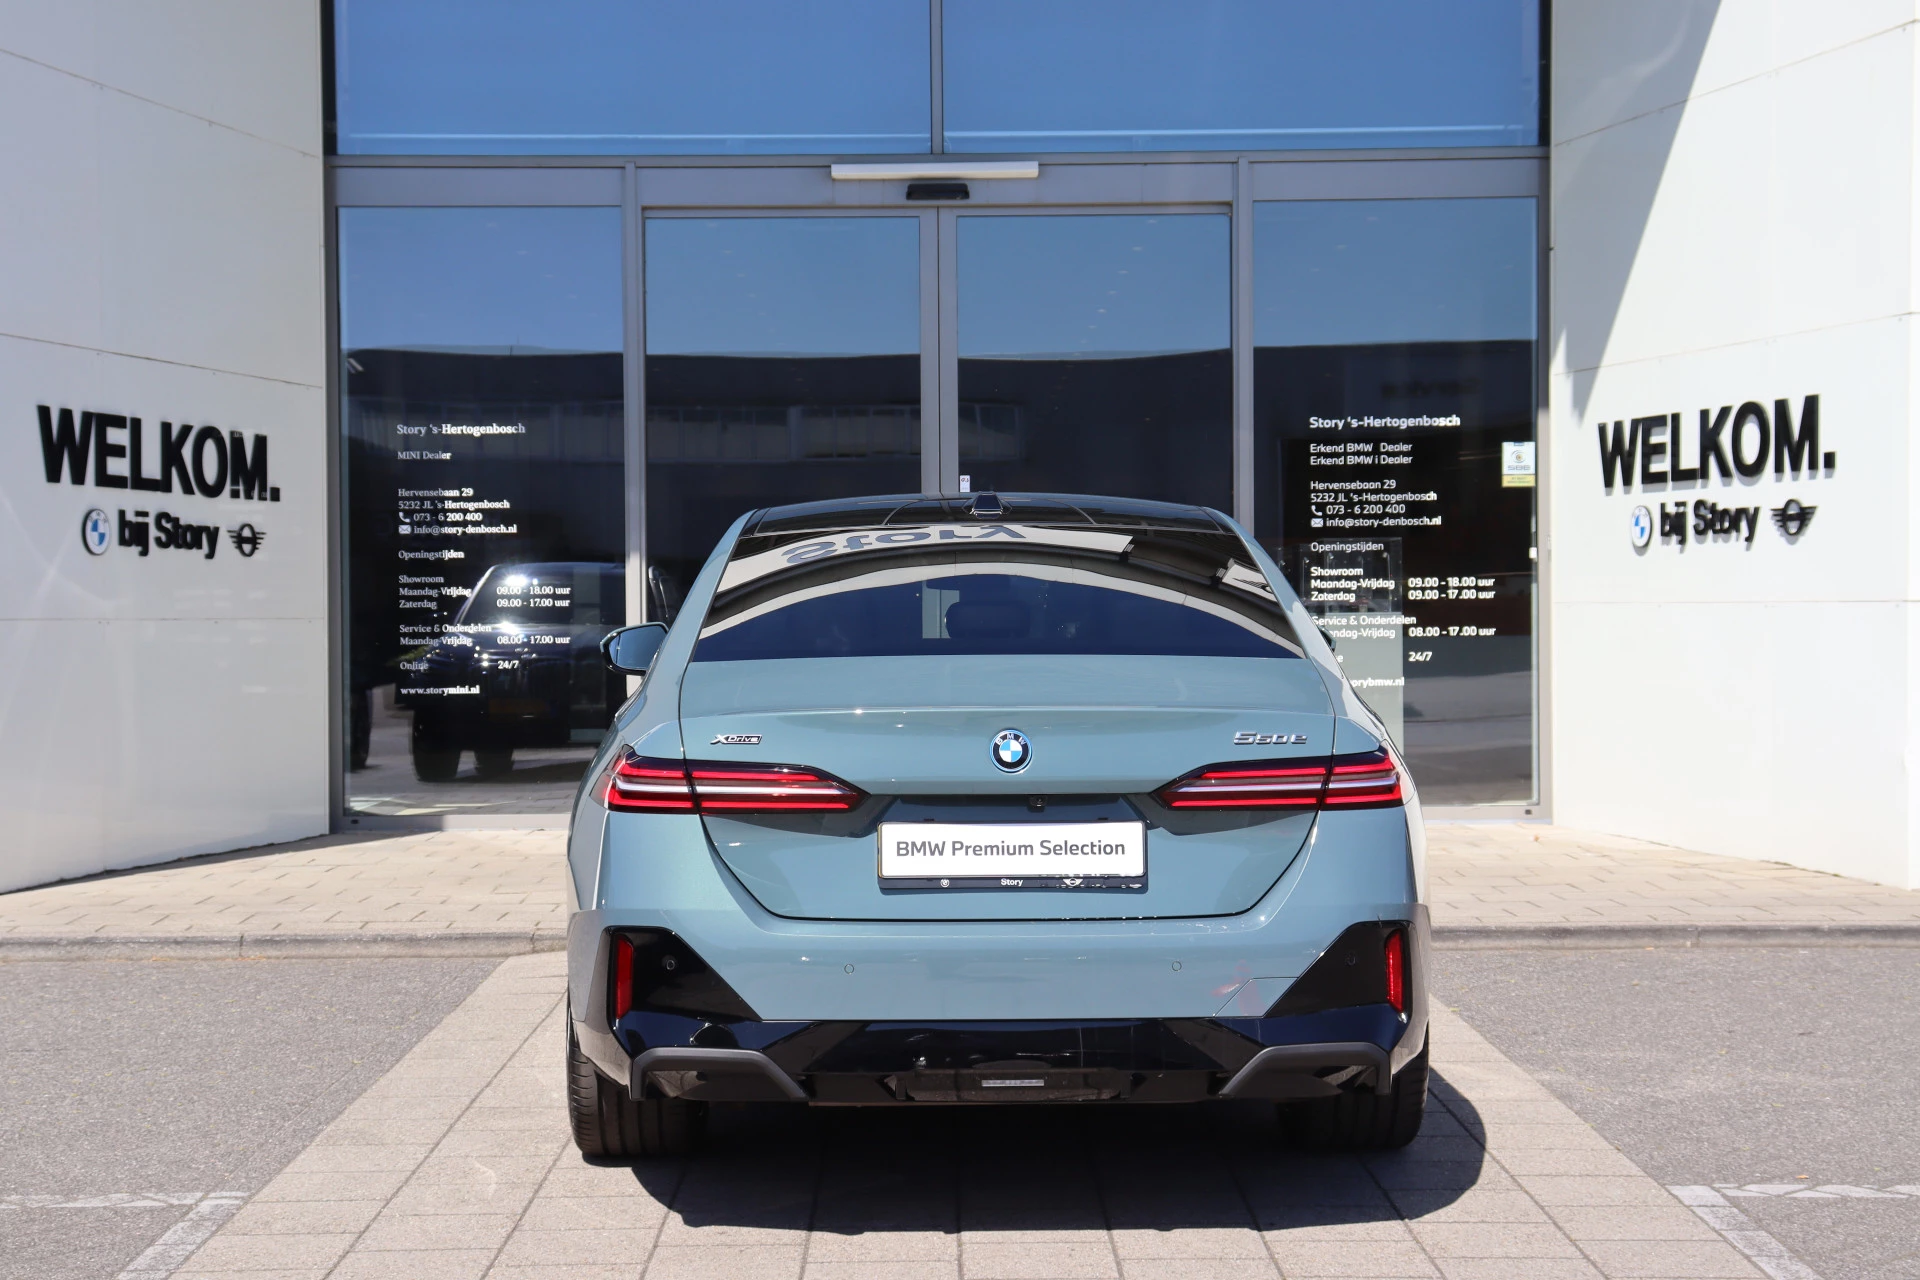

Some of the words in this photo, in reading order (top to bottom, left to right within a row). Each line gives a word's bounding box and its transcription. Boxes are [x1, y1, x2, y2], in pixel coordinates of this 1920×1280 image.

[1309, 417, 1344, 430] Story
[397, 424, 426, 436] Story
[1598, 394, 1836, 488] WELKOM.
[1310, 443, 1344, 452] Erkend
[1347, 443, 1373, 452] BMW
[1380, 443, 1412, 452] Dealer
[37, 405, 280, 502] WELKOM.
[423, 451, 451, 459] Dealer
[1310, 456, 1344, 465] Erkend
[1347, 456, 1373, 465] BMW
[1375, 456, 1378, 464] i
[1381, 455, 1412, 464] Dealer
[1311, 480, 1381, 490] Hervensebaan
[1383, 480, 1396, 489] 29
[398, 489, 460, 497] Hervensebaan
[461, 488, 473, 496] 29
[1311, 493, 1335, 502] 5232
[1337, 493, 1348, 502] JL
[398, 501, 420, 509] 5232
[422, 501, 433, 509] JL
[1326, 505, 1344, 514] 073
[1354, 505, 1360, 514] 6
[1363, 505, 1383, 514] 200
[1385, 504, 1405, 514] 400
[414, 513, 430, 521] 073
[438, 513, 444, 521] 6
[447, 513, 464, 521] 200
[465, 513, 482, 521] 400
[1326, 516, 1441, 528] info@story-denbosch.nl
[1660, 501, 1687, 546] bij
[1694, 499, 1761, 543] Story
[118, 510, 149, 557] bij
[154, 512, 220, 559] Story
[414, 524, 517, 537] info@story-denbosch.nl
[1311, 542, 1384, 553] Openingstijden
[398, 550, 464, 561] Openingstijden
[1311, 567, 1363, 576] Showroom
[399, 575, 444, 583] Showroom
[1311, 578, 1395, 590] Maandag-Vrijdag
[1408, 578, 1438, 587] 09.00
[1447, 577, 1476, 587] 18.00
[1478, 578, 1495, 586] uur
[400, 587, 472, 597] Maandag-Vrijdag
[497, 587, 521, 595] 09.00
[530, 586, 553, 595] 18.00
[1311, 591, 1355, 603] Zaterdag
[1408, 590, 1438, 600] 09.00
[1478, 591, 1495, 599] uur
[399, 600, 437, 610] Zaterdag
[497, 599, 521, 607] 09.00
[530, 599, 553, 607] 17.00
[1312, 616, 1347, 625] Service
[1350, 616, 1358, 624] &
[1360, 615, 1416, 625] Onderdelen
[400, 625, 431, 633] Service
[442, 624, 492, 633] Onderdelen
[1409, 627, 1439, 637] 08.00
[400, 637, 473, 647] Maandag-Vrijdag
[497, 636, 521, 645] 08.00
[530, 636, 553, 644] 17.00
[1409, 652, 1432, 661] 24/7
[400, 662, 428, 670] Online
[498, 661, 519, 669] 24/7
[401, 685, 480, 696] www.storymini.nl
[1234, 731, 1308, 745] 550e
[896, 841, 945, 856] BMW
[952, 841, 1034, 856] Premium
[1040, 839, 1125, 856] Selection
[1001, 879, 1023, 887] Story
